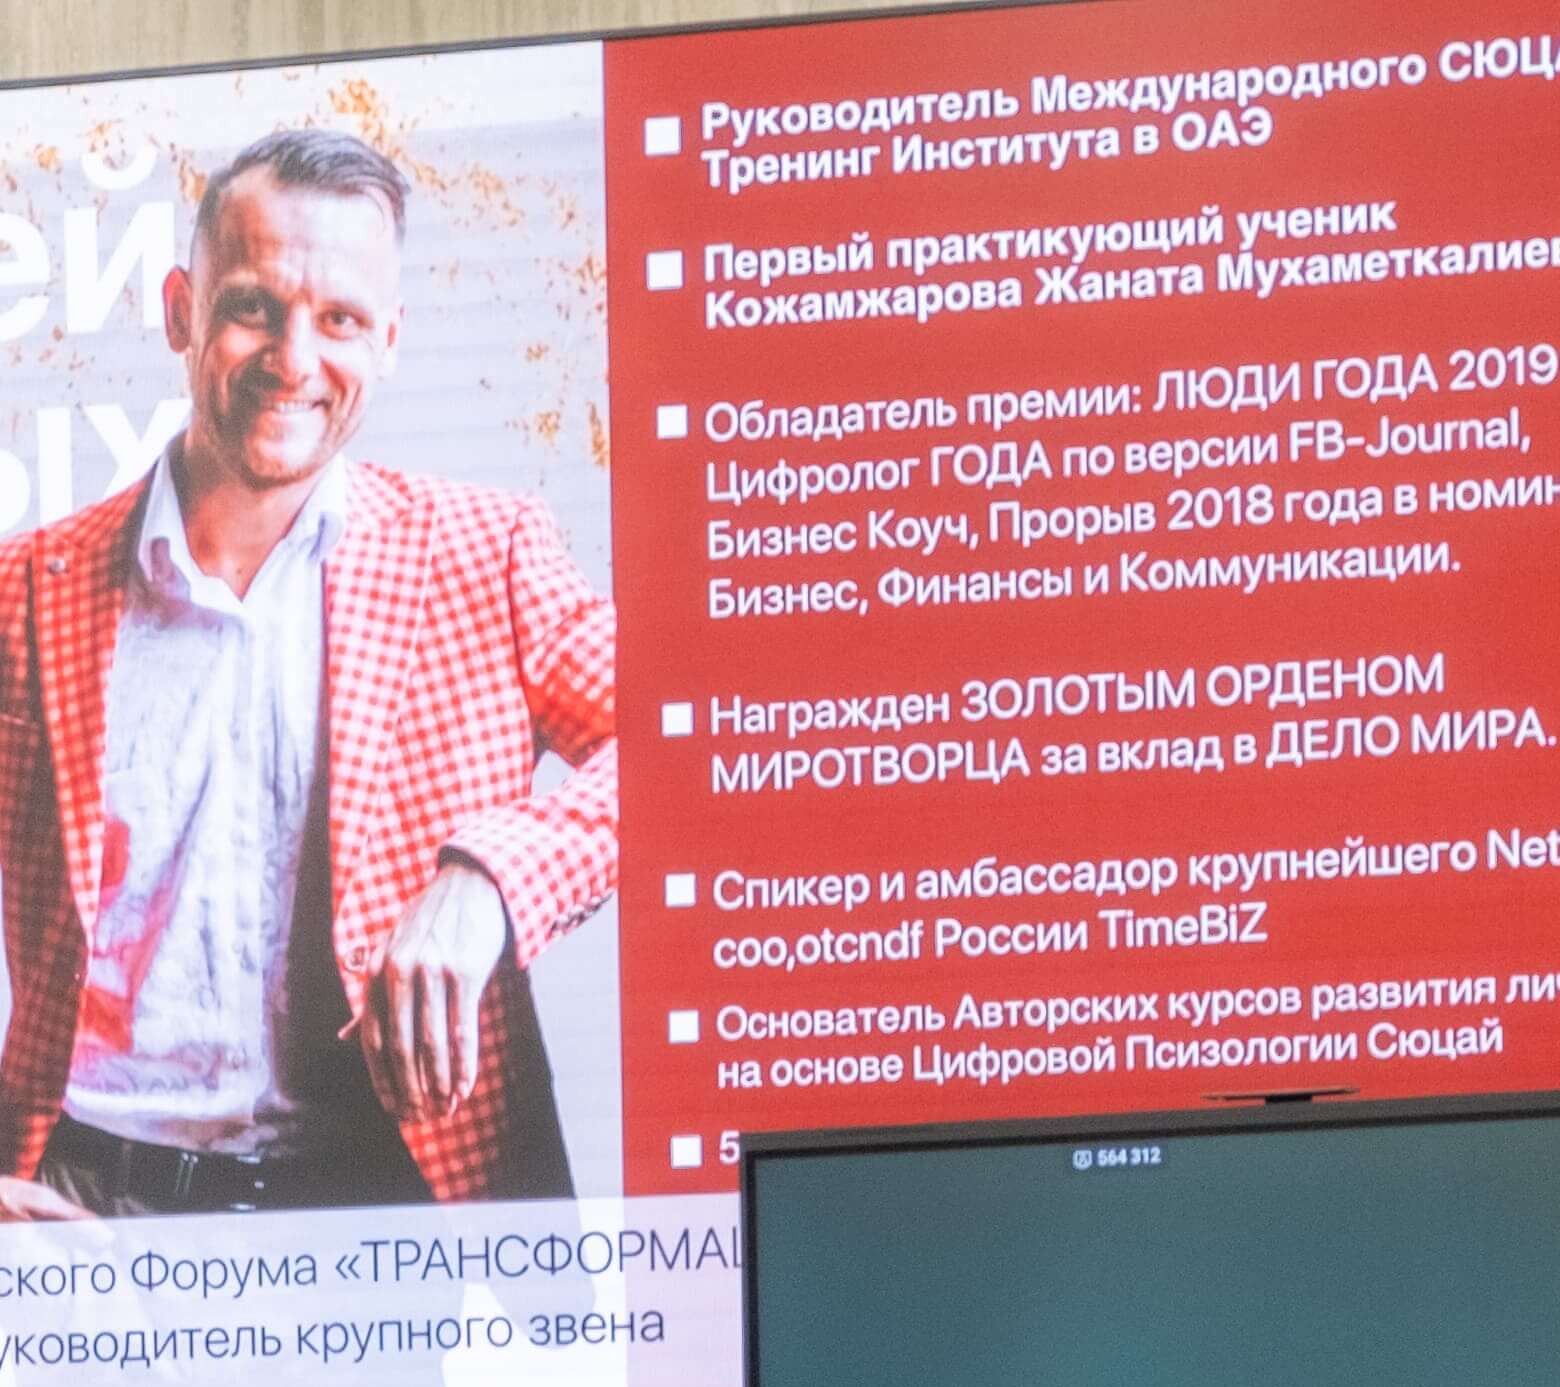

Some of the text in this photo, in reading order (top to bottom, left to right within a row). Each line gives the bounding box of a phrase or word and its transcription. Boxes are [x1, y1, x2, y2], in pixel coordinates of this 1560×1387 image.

[701, 87, 1020, 149] Руководитель
[1030, 53, 1428, 115] Международного
[700, 105, 1274, 196] Тренинг Института в ОАЭ
[703, 200, 1398, 285] Первый практикующий ученик
[705, 276, 1023, 330] Кожамжарова
[1034, 263, 1205, 306] Жаната
[704, 396, 958, 443] Обладатель
[966, 383, 1142, 432] премии:
[1152, 361, 1301, 414] ЛЮДИ
[1313, 352, 1440, 404] ГОДА
[1448, 342, 1559, 391] 2019
[706, 406, 1531, 507] Цифролог ГОДА по версии FB-Journal,
[707, 519, 858, 561] Бизнес
[867, 508, 979, 556] Коуч,
[989, 500, 1157, 548] Прорыв
[1167, 483, 1275, 531] 2018
[1283, 485, 1384, 527] года
[1393, 483, 1419, 516] в
[708, 541, 1461, 619] Бизнес, Финансы и Коммуникации.
[710, 652, 1445, 740] Награжден ЗОЛОТЫМ ОРДЕНОМ
[711, 706, 1557, 794] МИРОТВОРЦА за вклад в ДЕЛО МИРА.
[712, 869, 871, 913] Спикер
[879, 871, 905, 903] и
[915, 856, 1179, 901] амбассадор
[1188, 835, 1478, 893] крупнейшего
[934, 917, 1089, 958] России
[1097, 900, 1269, 949] TimeBiZ
[715, 1004, 946, 1042] Основатель
[953, 993, 1159, 1034] Авторских
[1167, 986, 1302, 1028] курсов
[1311, 976, 1497, 1021] развития
[717, 1017, 1504, 1089] на основе Цифровой Псизологии Сюцай
[1097, 1146, 1162, 1166] 564 312
[130, 1249, 318, 1299] Форума
[335, 1225, 742, 1282] «ТРАНСФОРМА
[296, 1315, 514, 1364] крупного
[528, 1309, 666, 1347] звена
